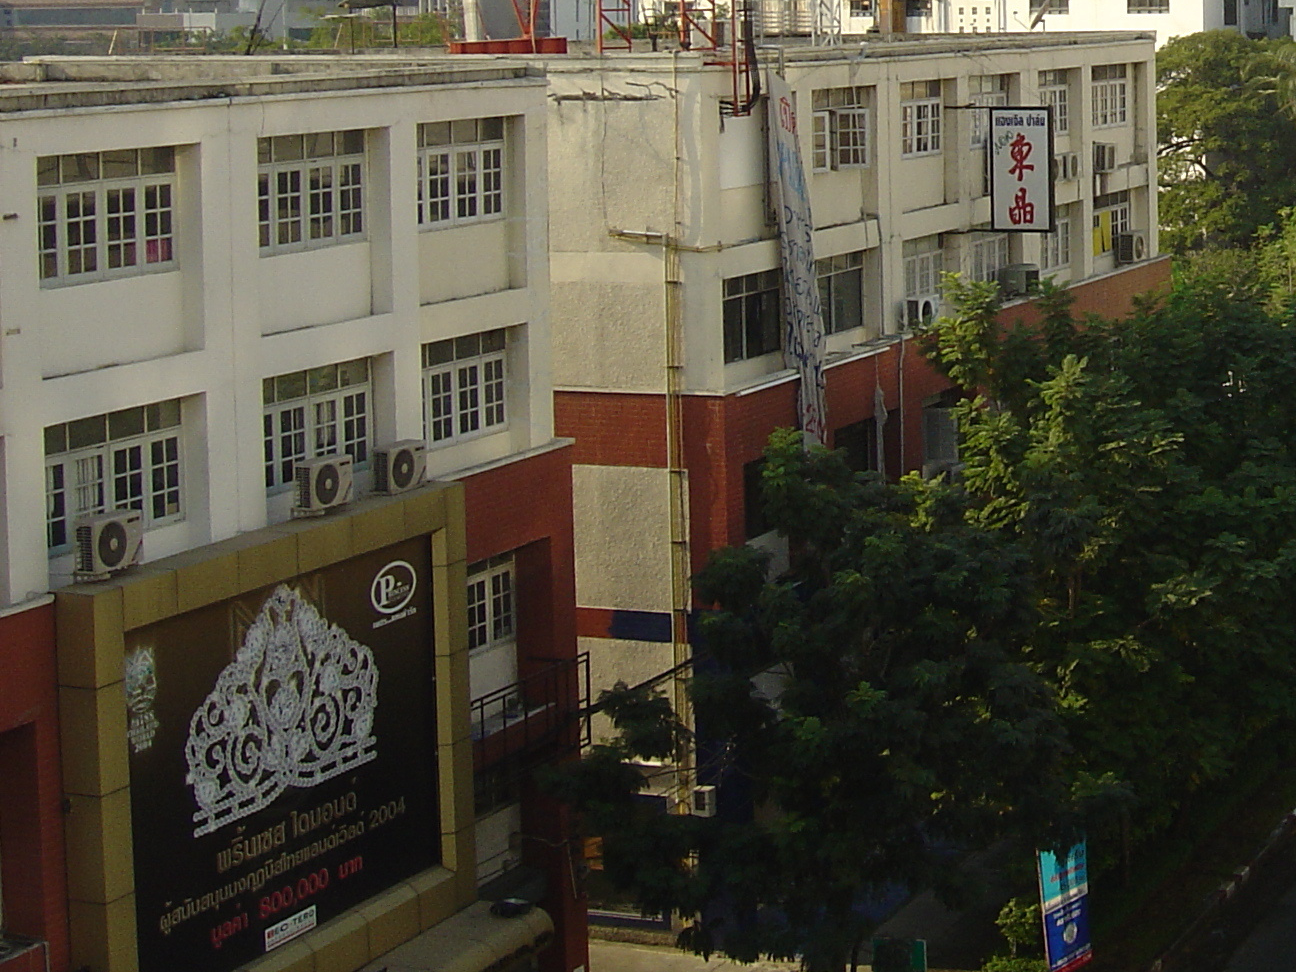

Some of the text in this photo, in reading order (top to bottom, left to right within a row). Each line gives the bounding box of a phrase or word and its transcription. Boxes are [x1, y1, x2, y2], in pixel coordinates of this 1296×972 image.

[369, 796, 406, 830] 2004
[258, 867, 330, 920] 800,000
[338, 856, 364, 880] บาท
